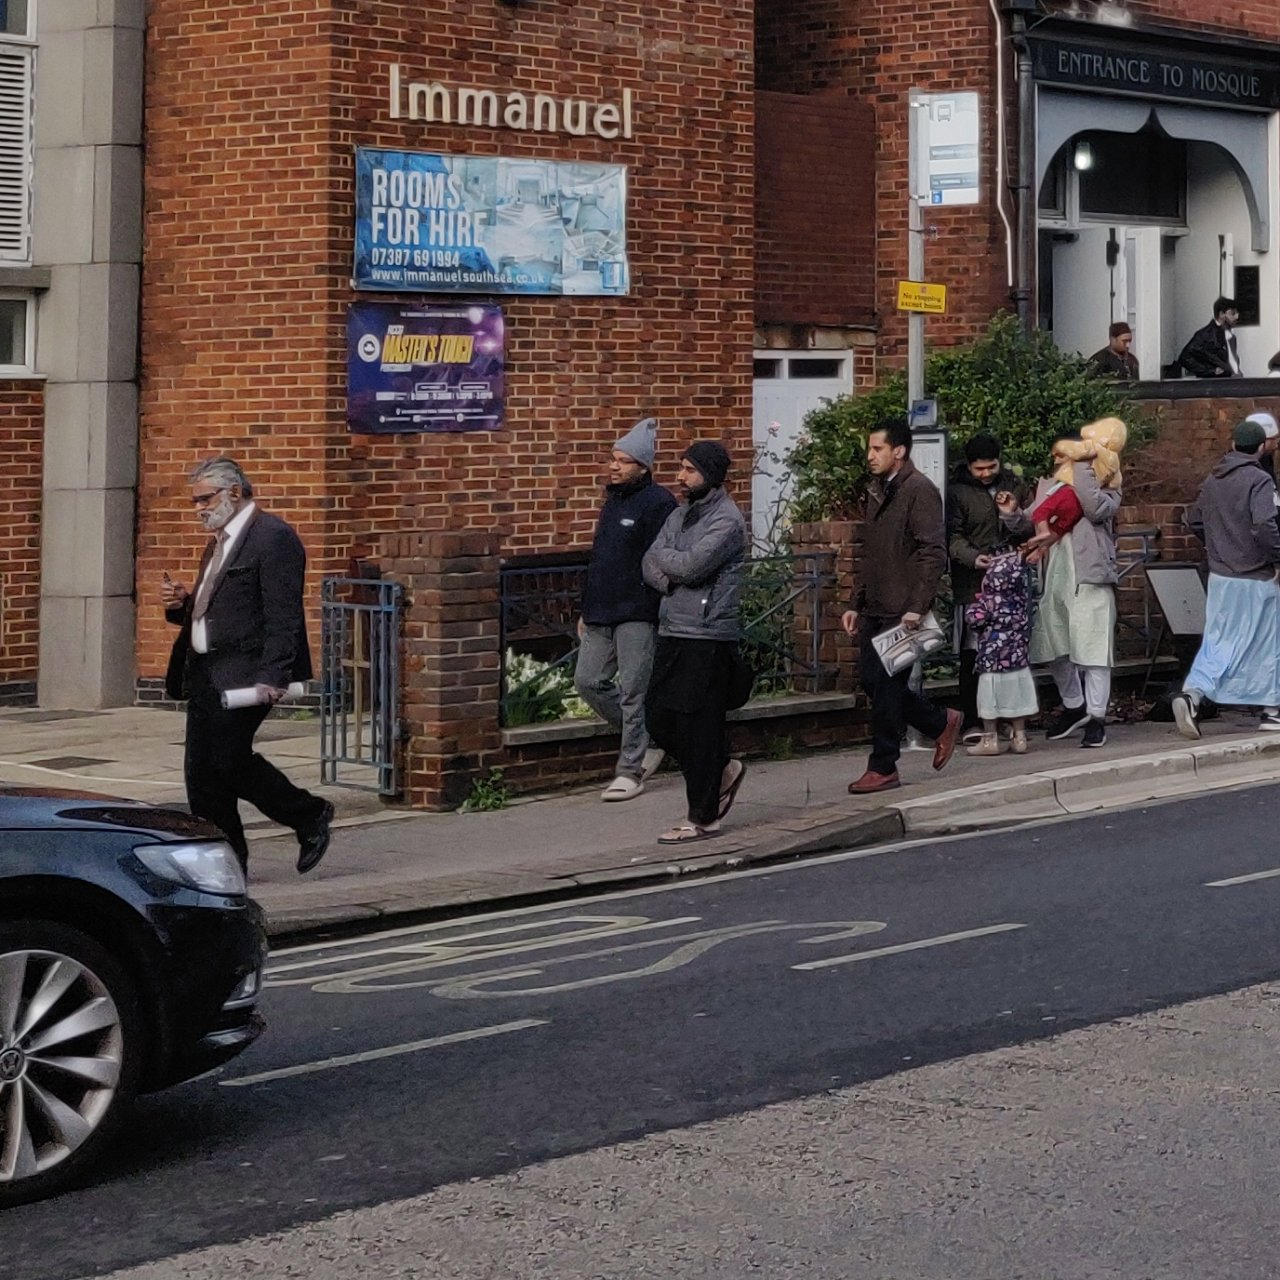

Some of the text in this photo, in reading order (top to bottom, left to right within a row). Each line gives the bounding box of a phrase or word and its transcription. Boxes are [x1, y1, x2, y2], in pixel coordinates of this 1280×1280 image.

[1058, 49, 1260, 98] ENTRANCE TO MOSQUE
[389, 63, 633, 138] Immanuel
[372, 169, 462, 209] ROOMS
[371, 207, 487, 247] FOR HIRE
[371, 248, 409, 266] 07387
[371, 269, 545, 284] www.immanuelsouthsea.co.uk
